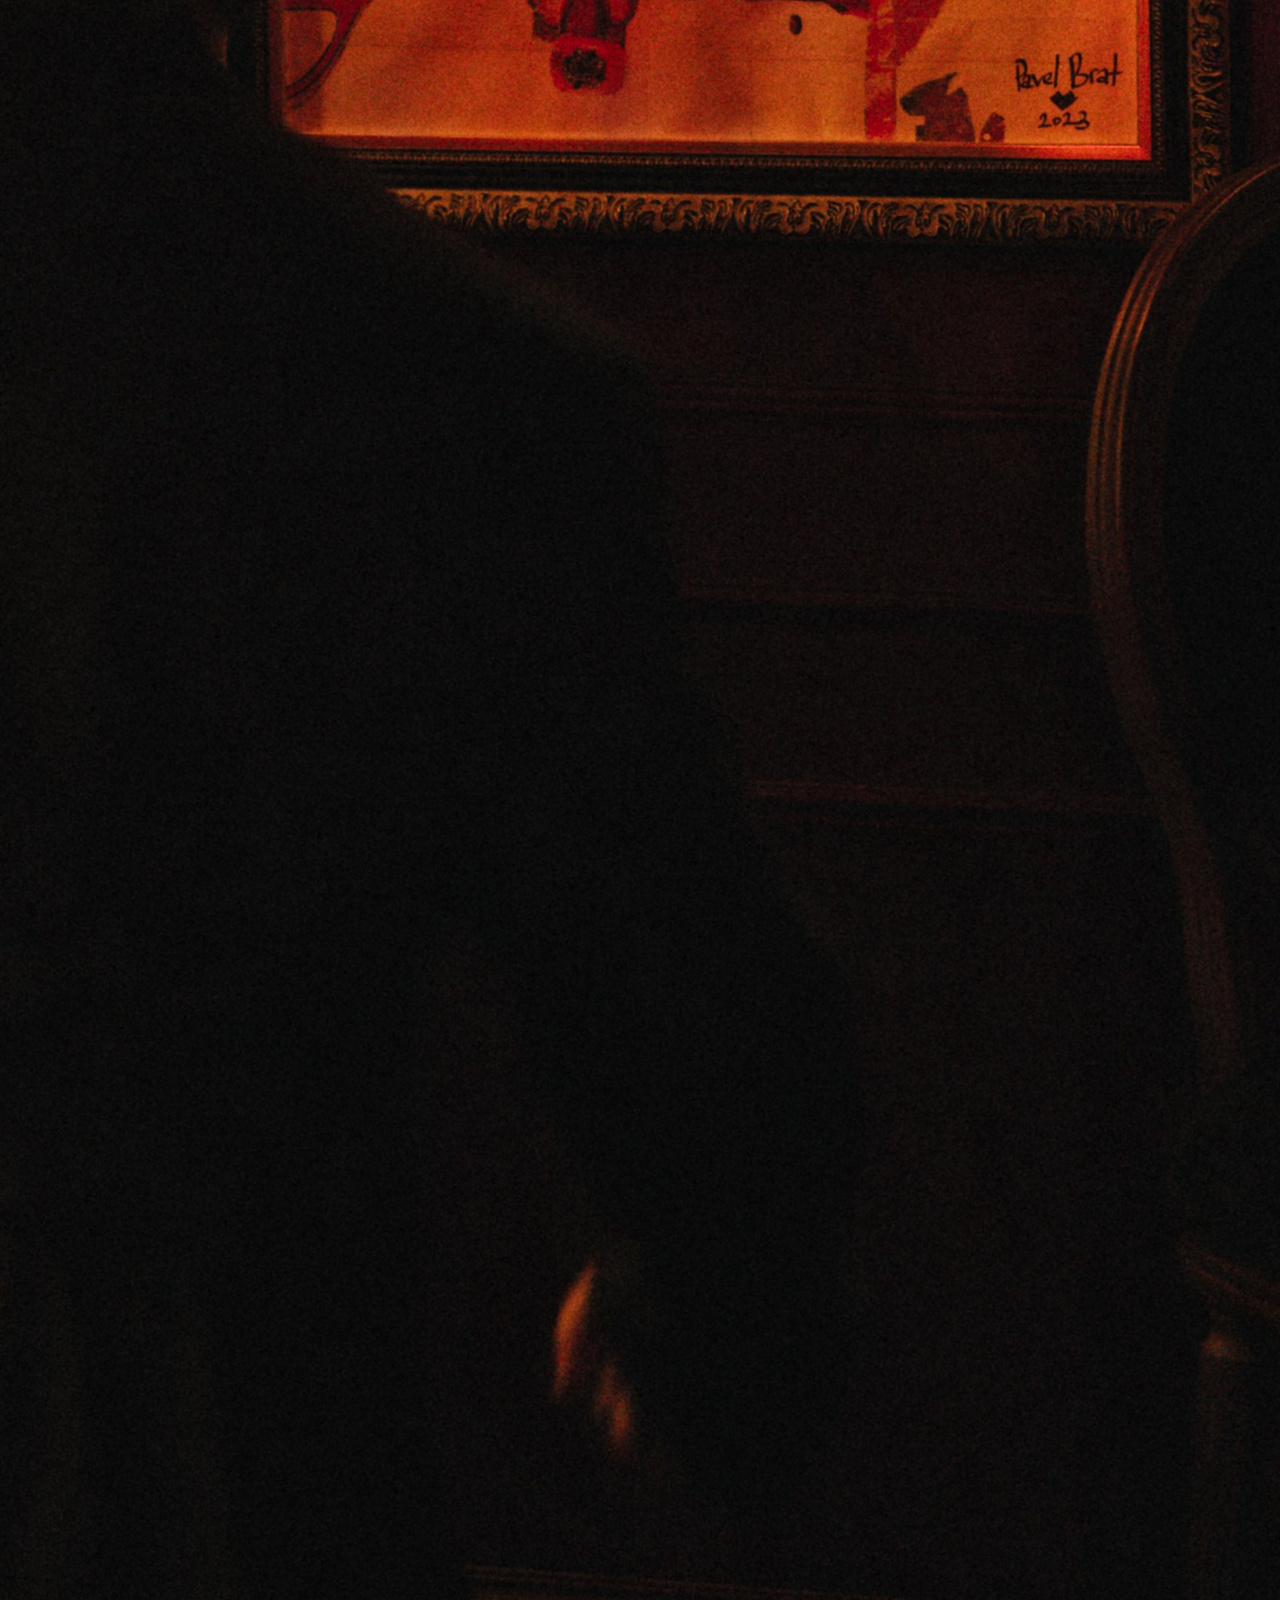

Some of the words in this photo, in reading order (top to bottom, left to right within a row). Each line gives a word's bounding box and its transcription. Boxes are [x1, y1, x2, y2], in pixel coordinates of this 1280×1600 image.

[1015, 53, 1060, 92] Pavel
[1068, 51, 1123, 90] Brat
[1037, 110, 1091, 130] 2023
